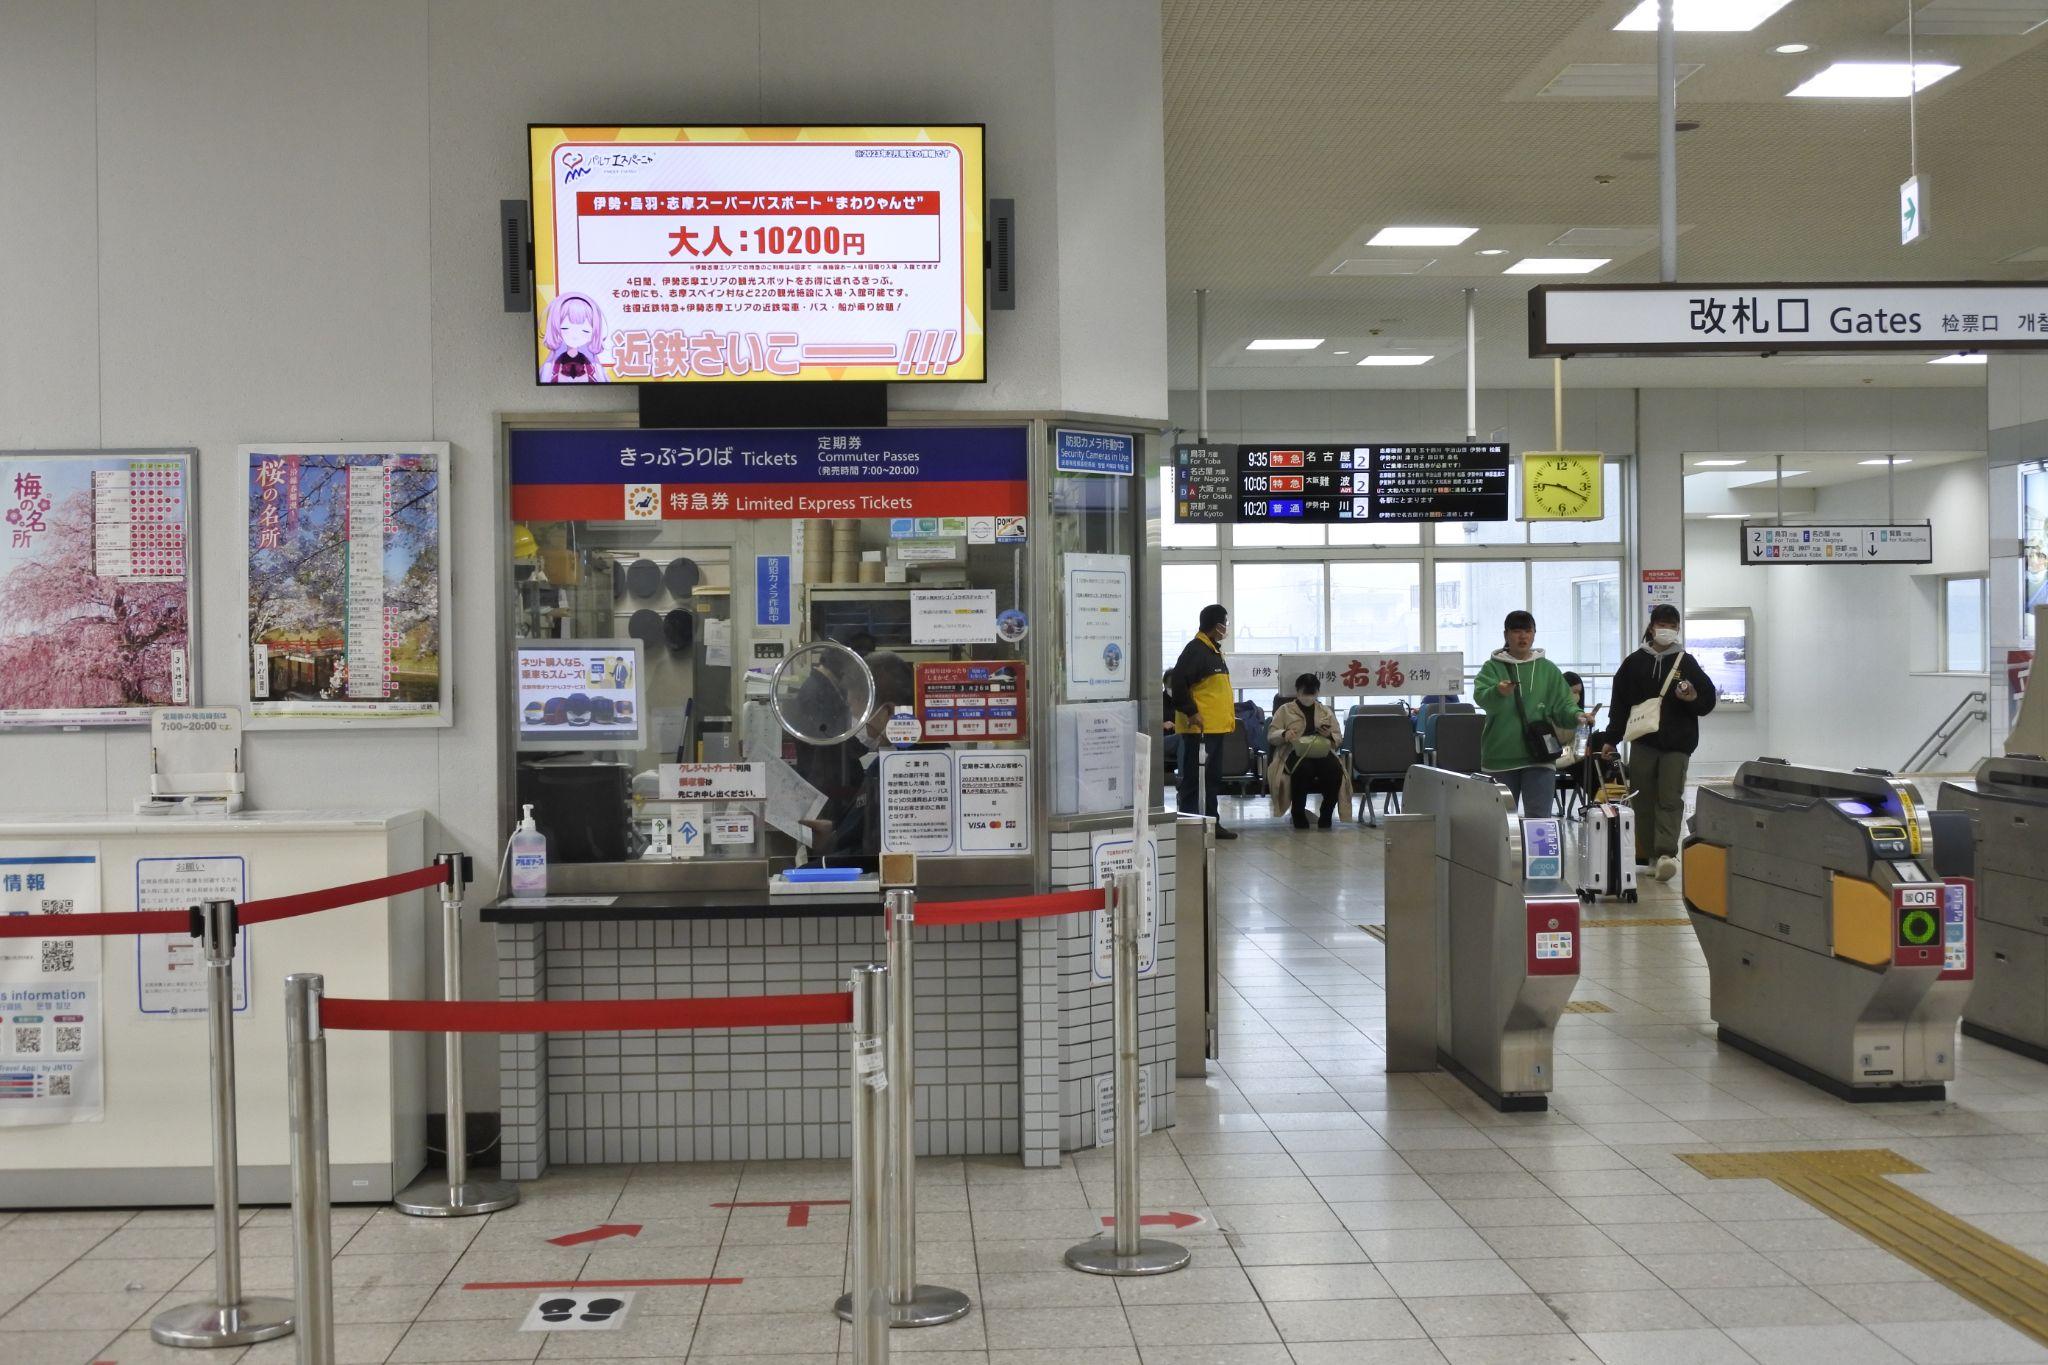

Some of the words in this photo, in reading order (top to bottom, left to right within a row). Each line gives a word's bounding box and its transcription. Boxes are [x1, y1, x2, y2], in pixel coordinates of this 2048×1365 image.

[1689, 297, 1809, 335] 改札口
[1829, 306, 1922, 334] Gates
[1942, 313, 1998, 333] 检票口
[817, 436, 862, 450] 定期券
[1065, 435, 1125, 451] 防犯カメラ作動中
[620, 447, 734, 466] きっぷうりば
[741, 451, 798, 466] Tickets
[817, 451, 881, 462] Commuter
[883, 451, 920, 461] Passes
[1061, 448, 1084, 460] Security
[1086, 450, 1111, 461] Cameras
[1119, 453, 1129, 462] Use
[1190, 450, 1206, 458] 鳥羽
[1248, 452, 1267, 467] 9:35
[1272, 454, 1301, 464] 特急
[1305, 451, 1351, 462] 名古屋
[1357, 456, 1366, 467] 2
[1190, 467, 1213, 476] 名古屋
[1557, 462, 1568, 471] 12
[1198, 485, 1214, 493] 大阪
[1244, 477, 1267, 491] 10:05
[1272, 479, 1301, 488] 特急
[1357, 480, 1366, 492] 2
[1537, 483, 1546, 492] 9
[1579, 482, 1587, 491] 3
[256, 458, 286, 549] 桜の名所
[670, 492, 729, 511] 特急券
[736, 496, 793, 511] Limited
[799, 496, 856, 513] Express
[860, 495, 913, 509] Tickets
[1190, 502, 1206, 510] 京都
[1244, 501, 1267, 516] 10:20
[1272, 503, 1300, 513] 普通
[1356, 505, 1365, 517] 2
[1558, 503, 1567, 512] 6
[12, 471, 48, 549] 梅の名所
[1754, 532, 1761, 542] 2
[1869, 531, 1875, 541] 1
[768, 557, 780, 623] 防犯カメラ作動中
[1252, 666, 1272, 677] 伊勢
[1314, 670, 1337, 683] 伊勢
[1409, 668, 1431, 681] 名物
[680, 763, 752, 773] クレジットカード利用
[678, 789, 757, 799] 先にお申し出ください。
[968, 821, 986, 829] VISA
[1547, 821, 1559, 856] PiTaPa
[176, 862, 206, 871] お願い
[3, 873, 46, 892] 情報
[1914, 891, 1935, 905] QR
[12, 989, 86, 1001] information
[53, 1063, 73, 1071] JNTO
